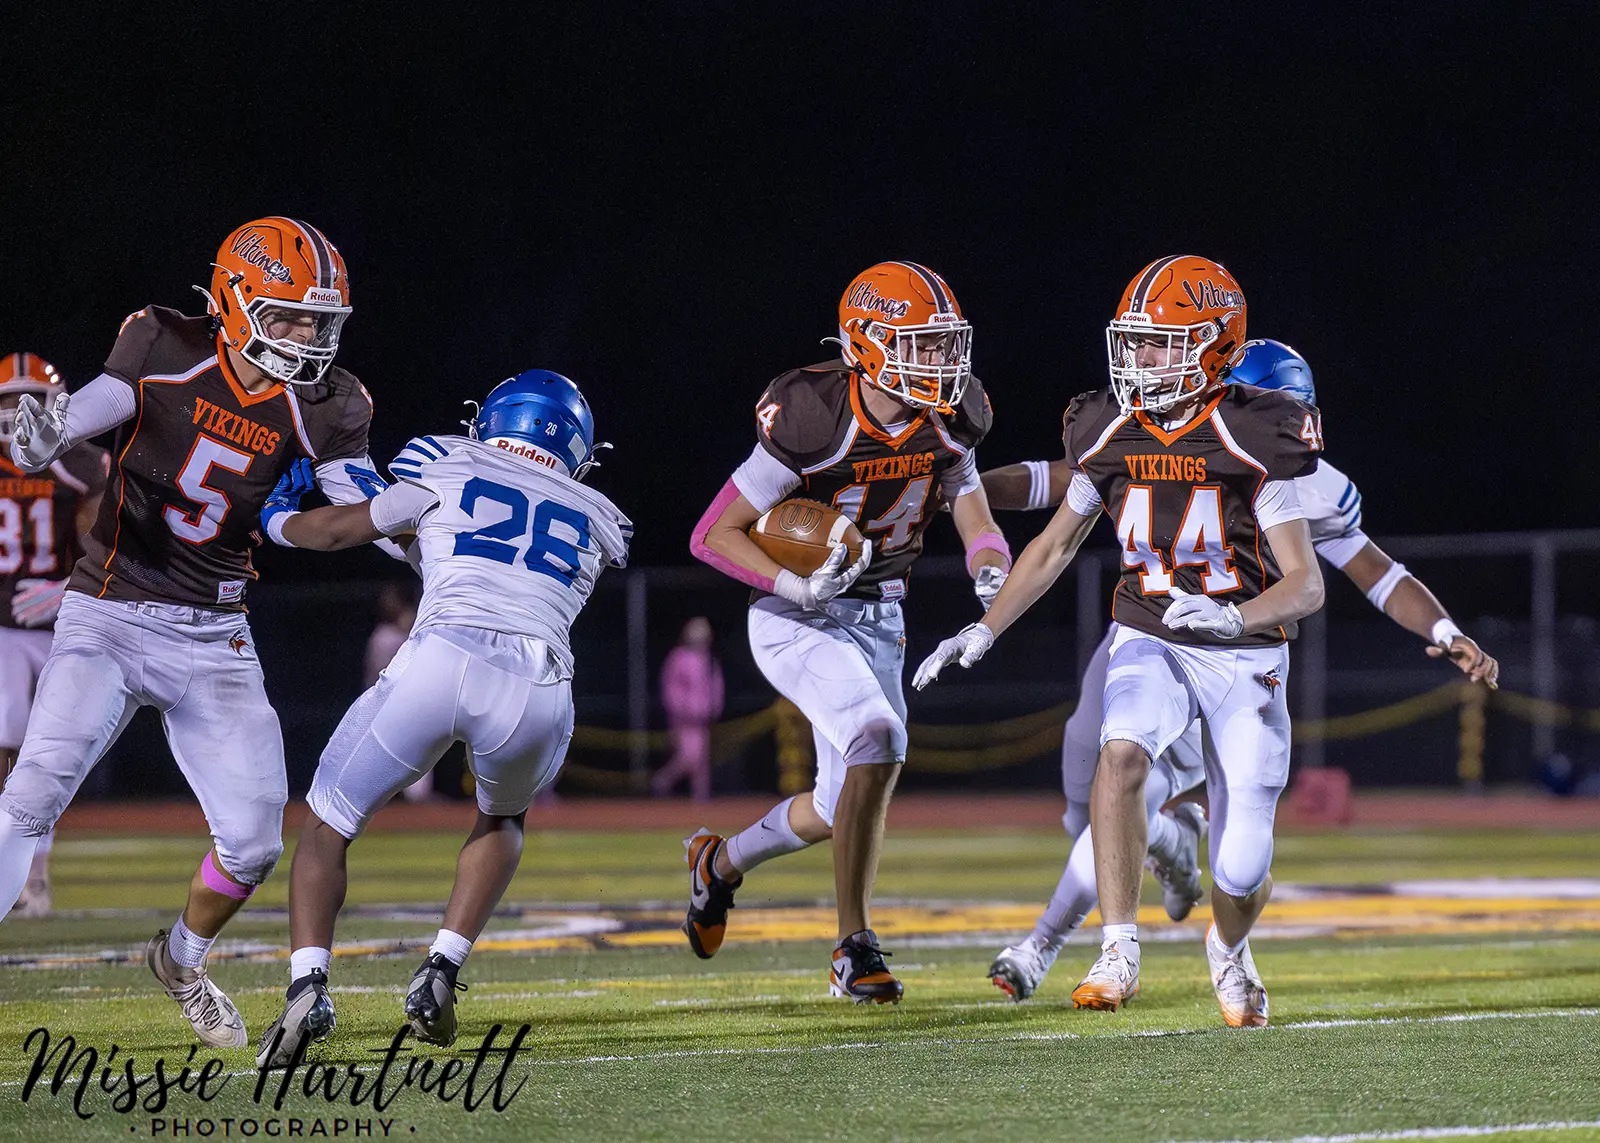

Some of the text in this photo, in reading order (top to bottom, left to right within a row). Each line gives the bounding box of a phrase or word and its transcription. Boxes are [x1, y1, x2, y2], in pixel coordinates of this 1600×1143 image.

[231, 227, 291, 284] Vikings
[846, 281, 911, 321] Vikings
[1182, 278, 1245, 314] Viking
[192, 397, 281, 455] VIKINGS
[545, 422, 558, 436] 26
[497, 439, 557, 469] Riddell
[852, 452, 935, 482] VIKINGS
[1124, 454, 1206, 482] VIKINGS
[161, 431, 255, 546] 5
[452, 477, 590, 588] 26
[832, 474, 933, 552] 14
[1116, 484, 1243, 596] 44
